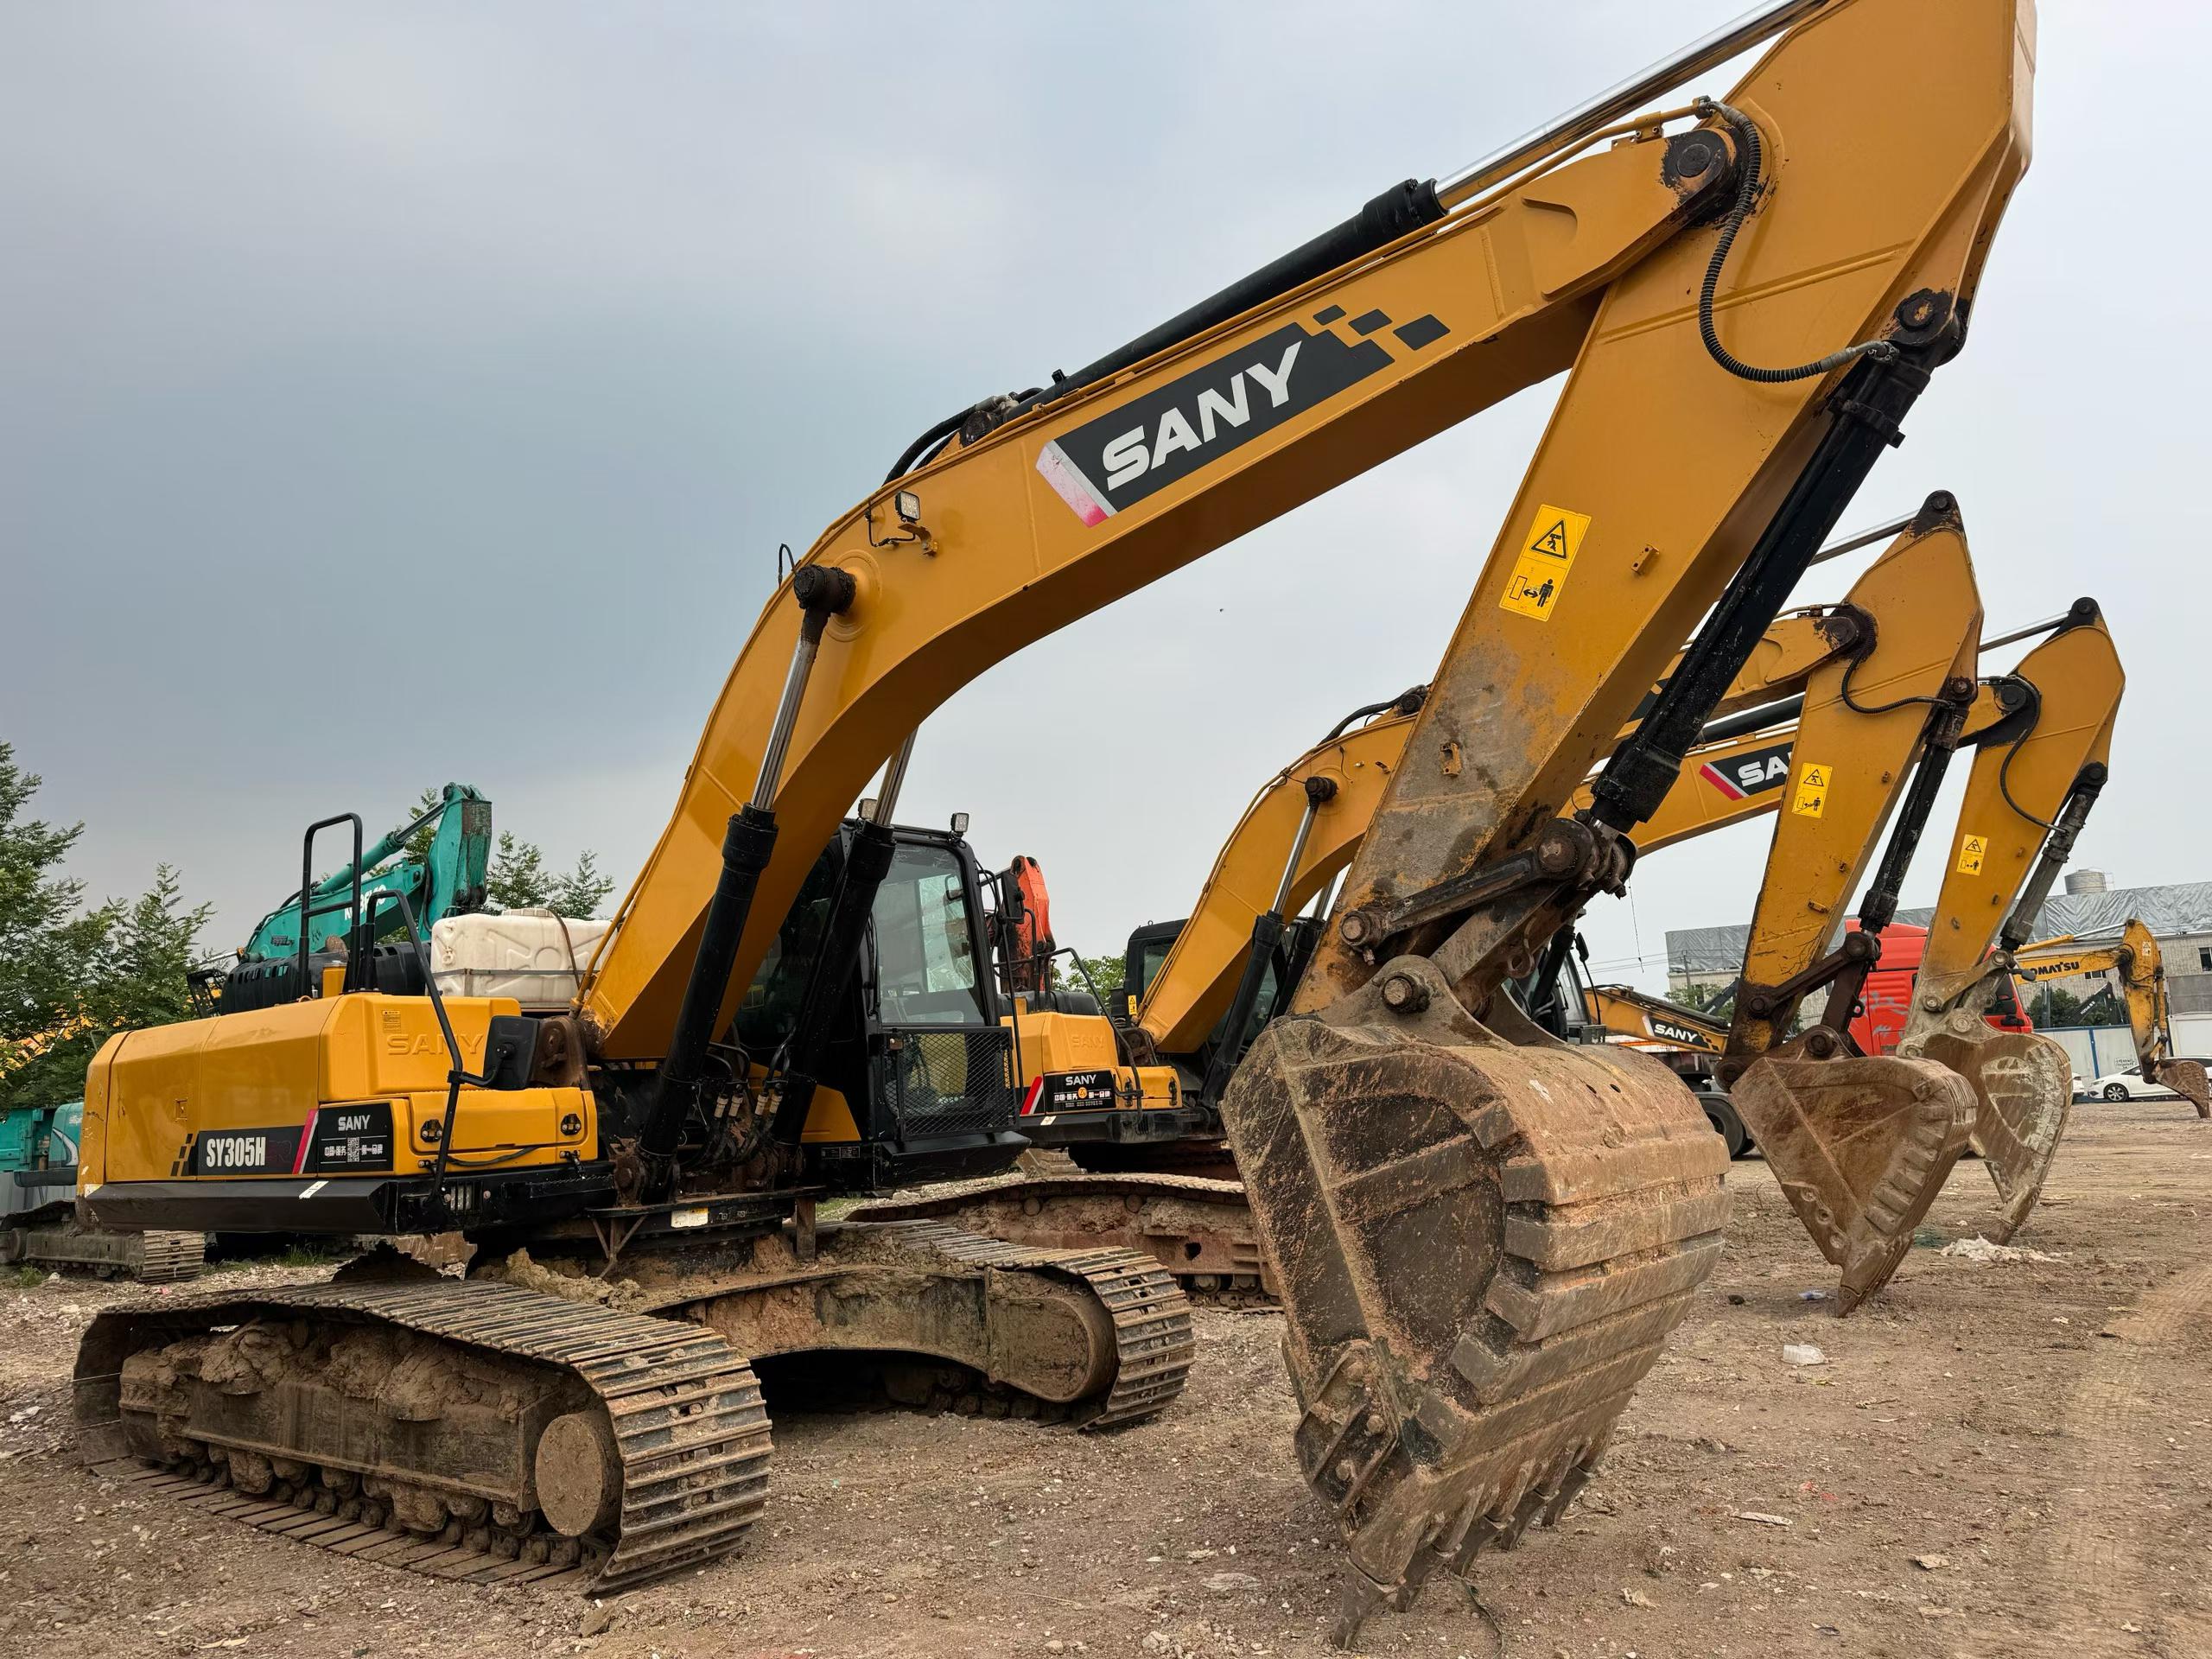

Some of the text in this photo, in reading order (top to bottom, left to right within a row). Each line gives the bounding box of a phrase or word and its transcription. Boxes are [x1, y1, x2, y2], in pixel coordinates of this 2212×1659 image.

[1103, 340, 1302, 491] SANY
[1738, 751, 1792, 787] SA
[2030, 961, 2080, 976] OMATSU
[1071, 1034, 1105, 1048] SANY
[1654, 1024, 1698, 1042] SANY
[1065, 1074, 1096, 1086] SANY
[338, 1115, 371, 1131] SANY
[206, 1136, 266, 1167] SY305H
